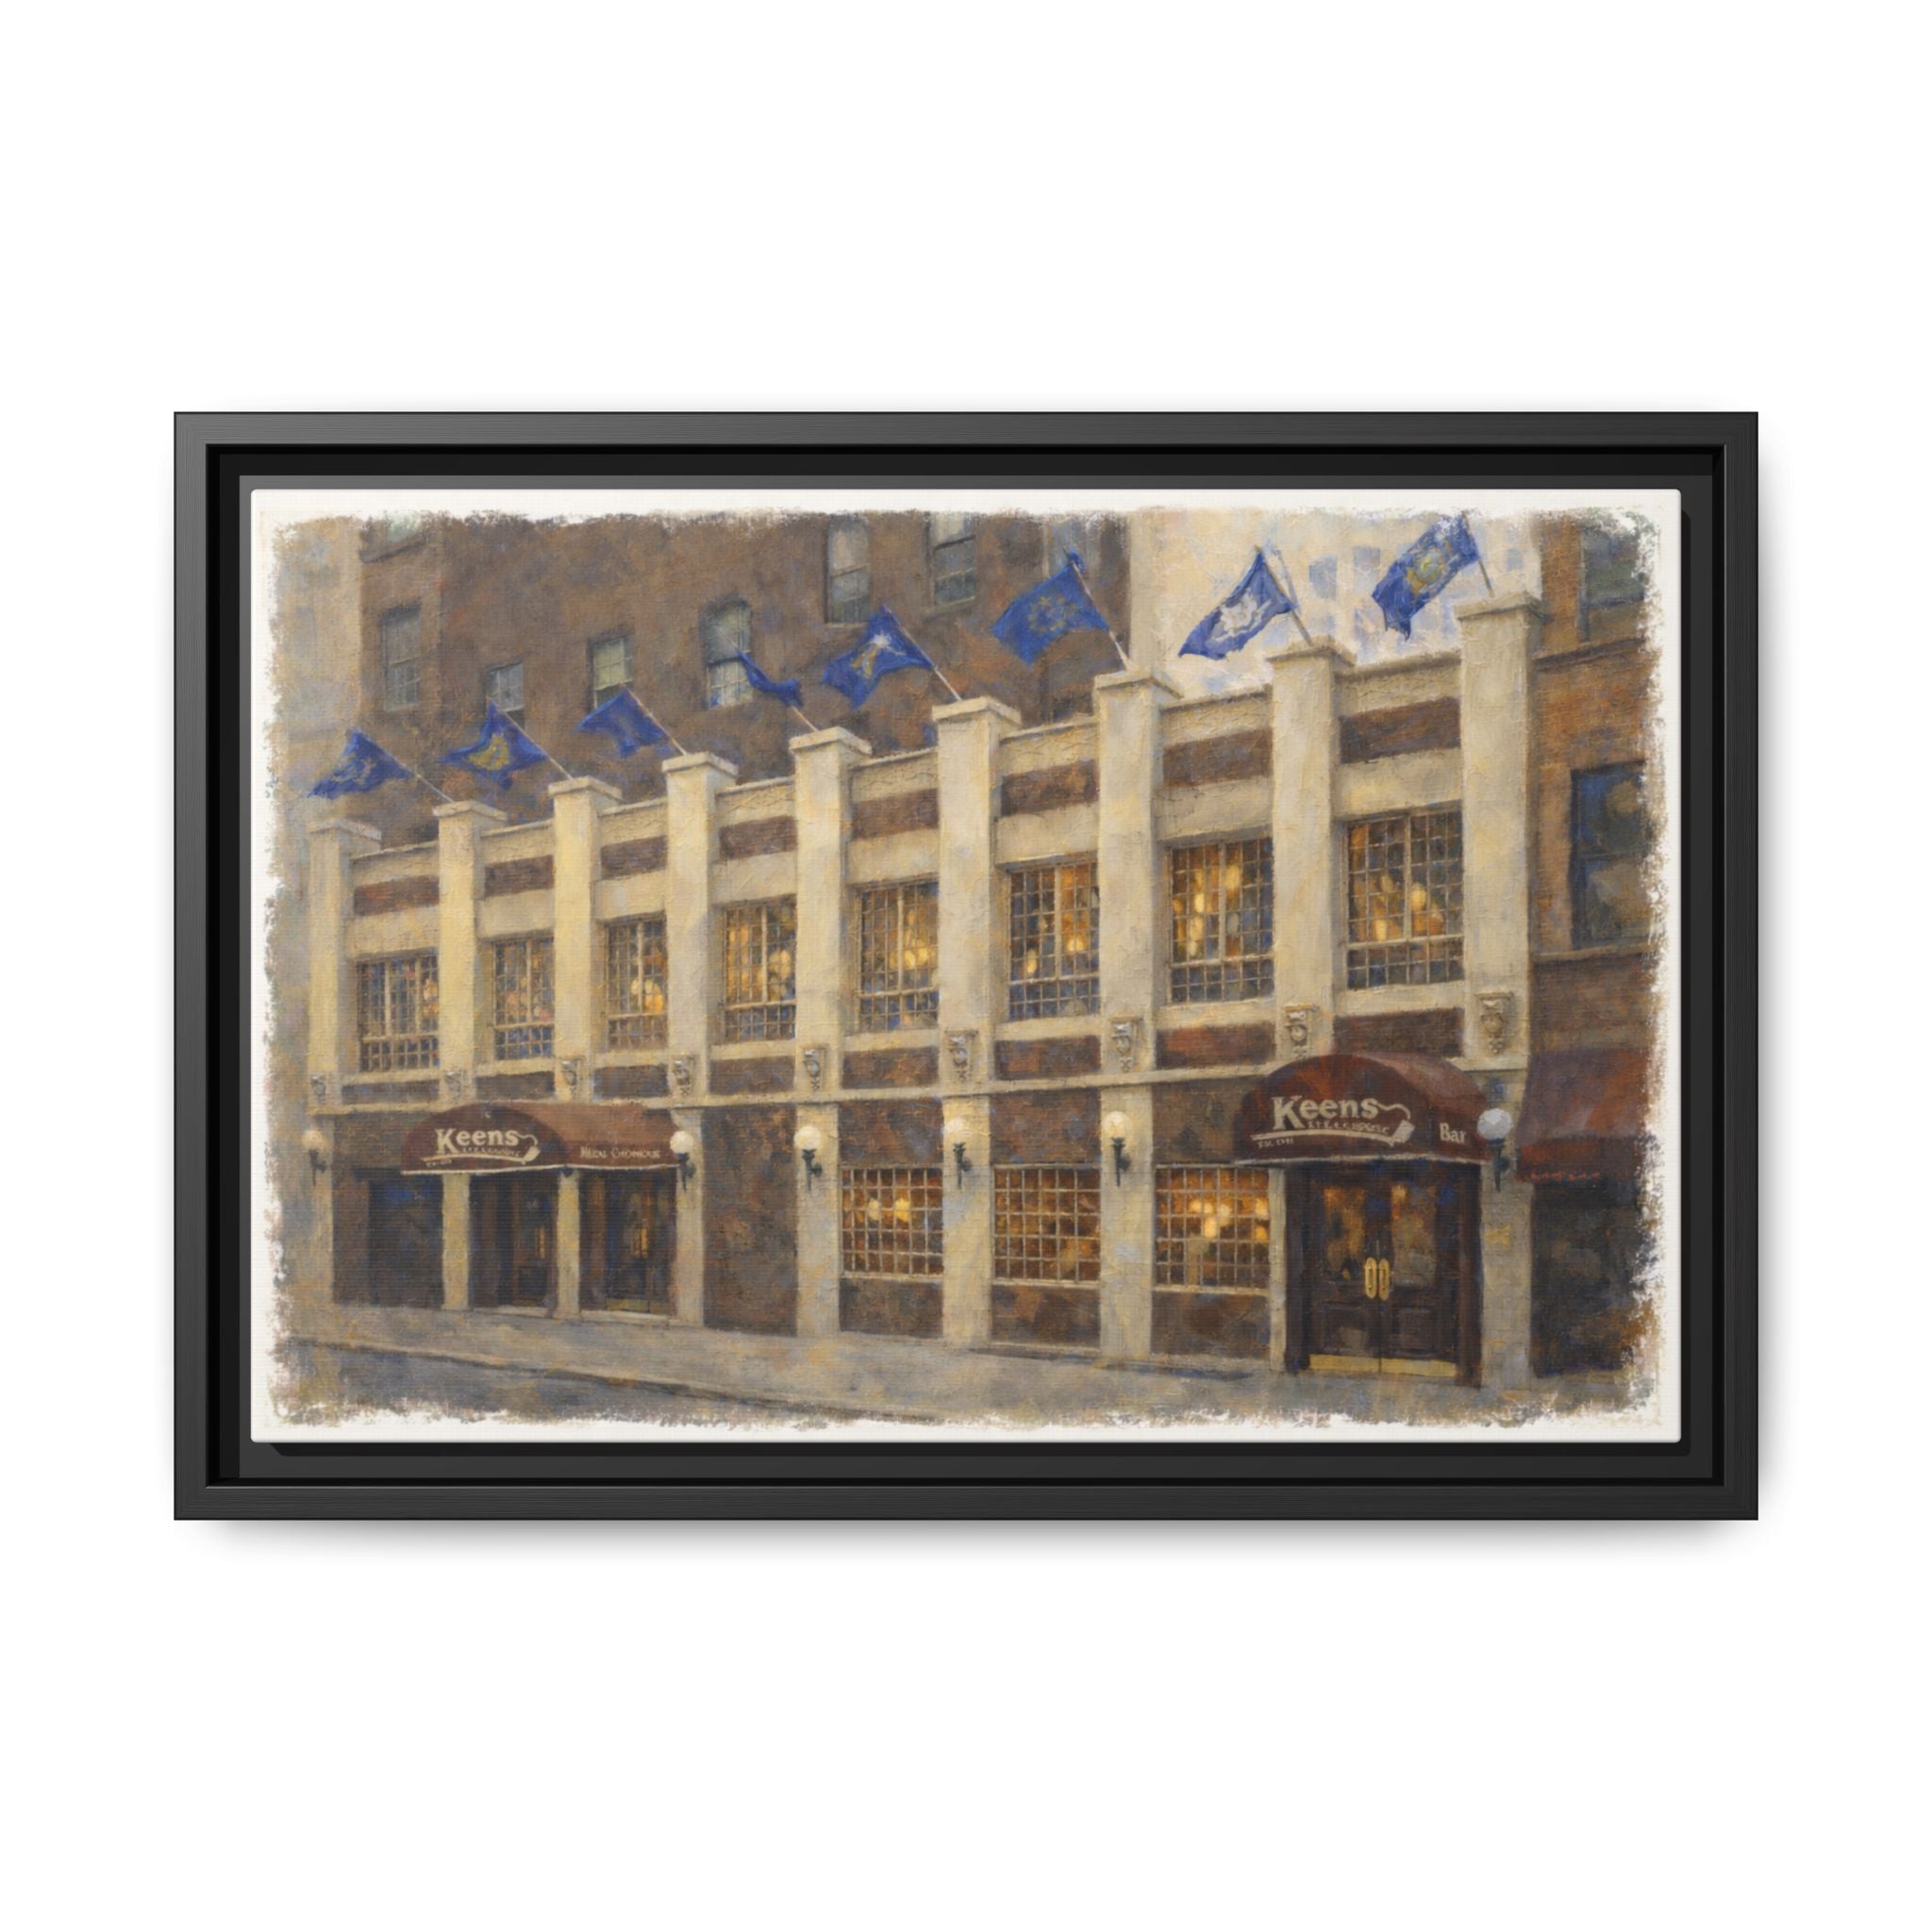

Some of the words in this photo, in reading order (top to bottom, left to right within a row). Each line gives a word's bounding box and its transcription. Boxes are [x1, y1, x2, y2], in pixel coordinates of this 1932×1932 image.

[1272, 1095, 1379, 1130] Keens
[434, 1129, 520, 1156] Keens
[1440, 1123, 1467, 1144] Bar
